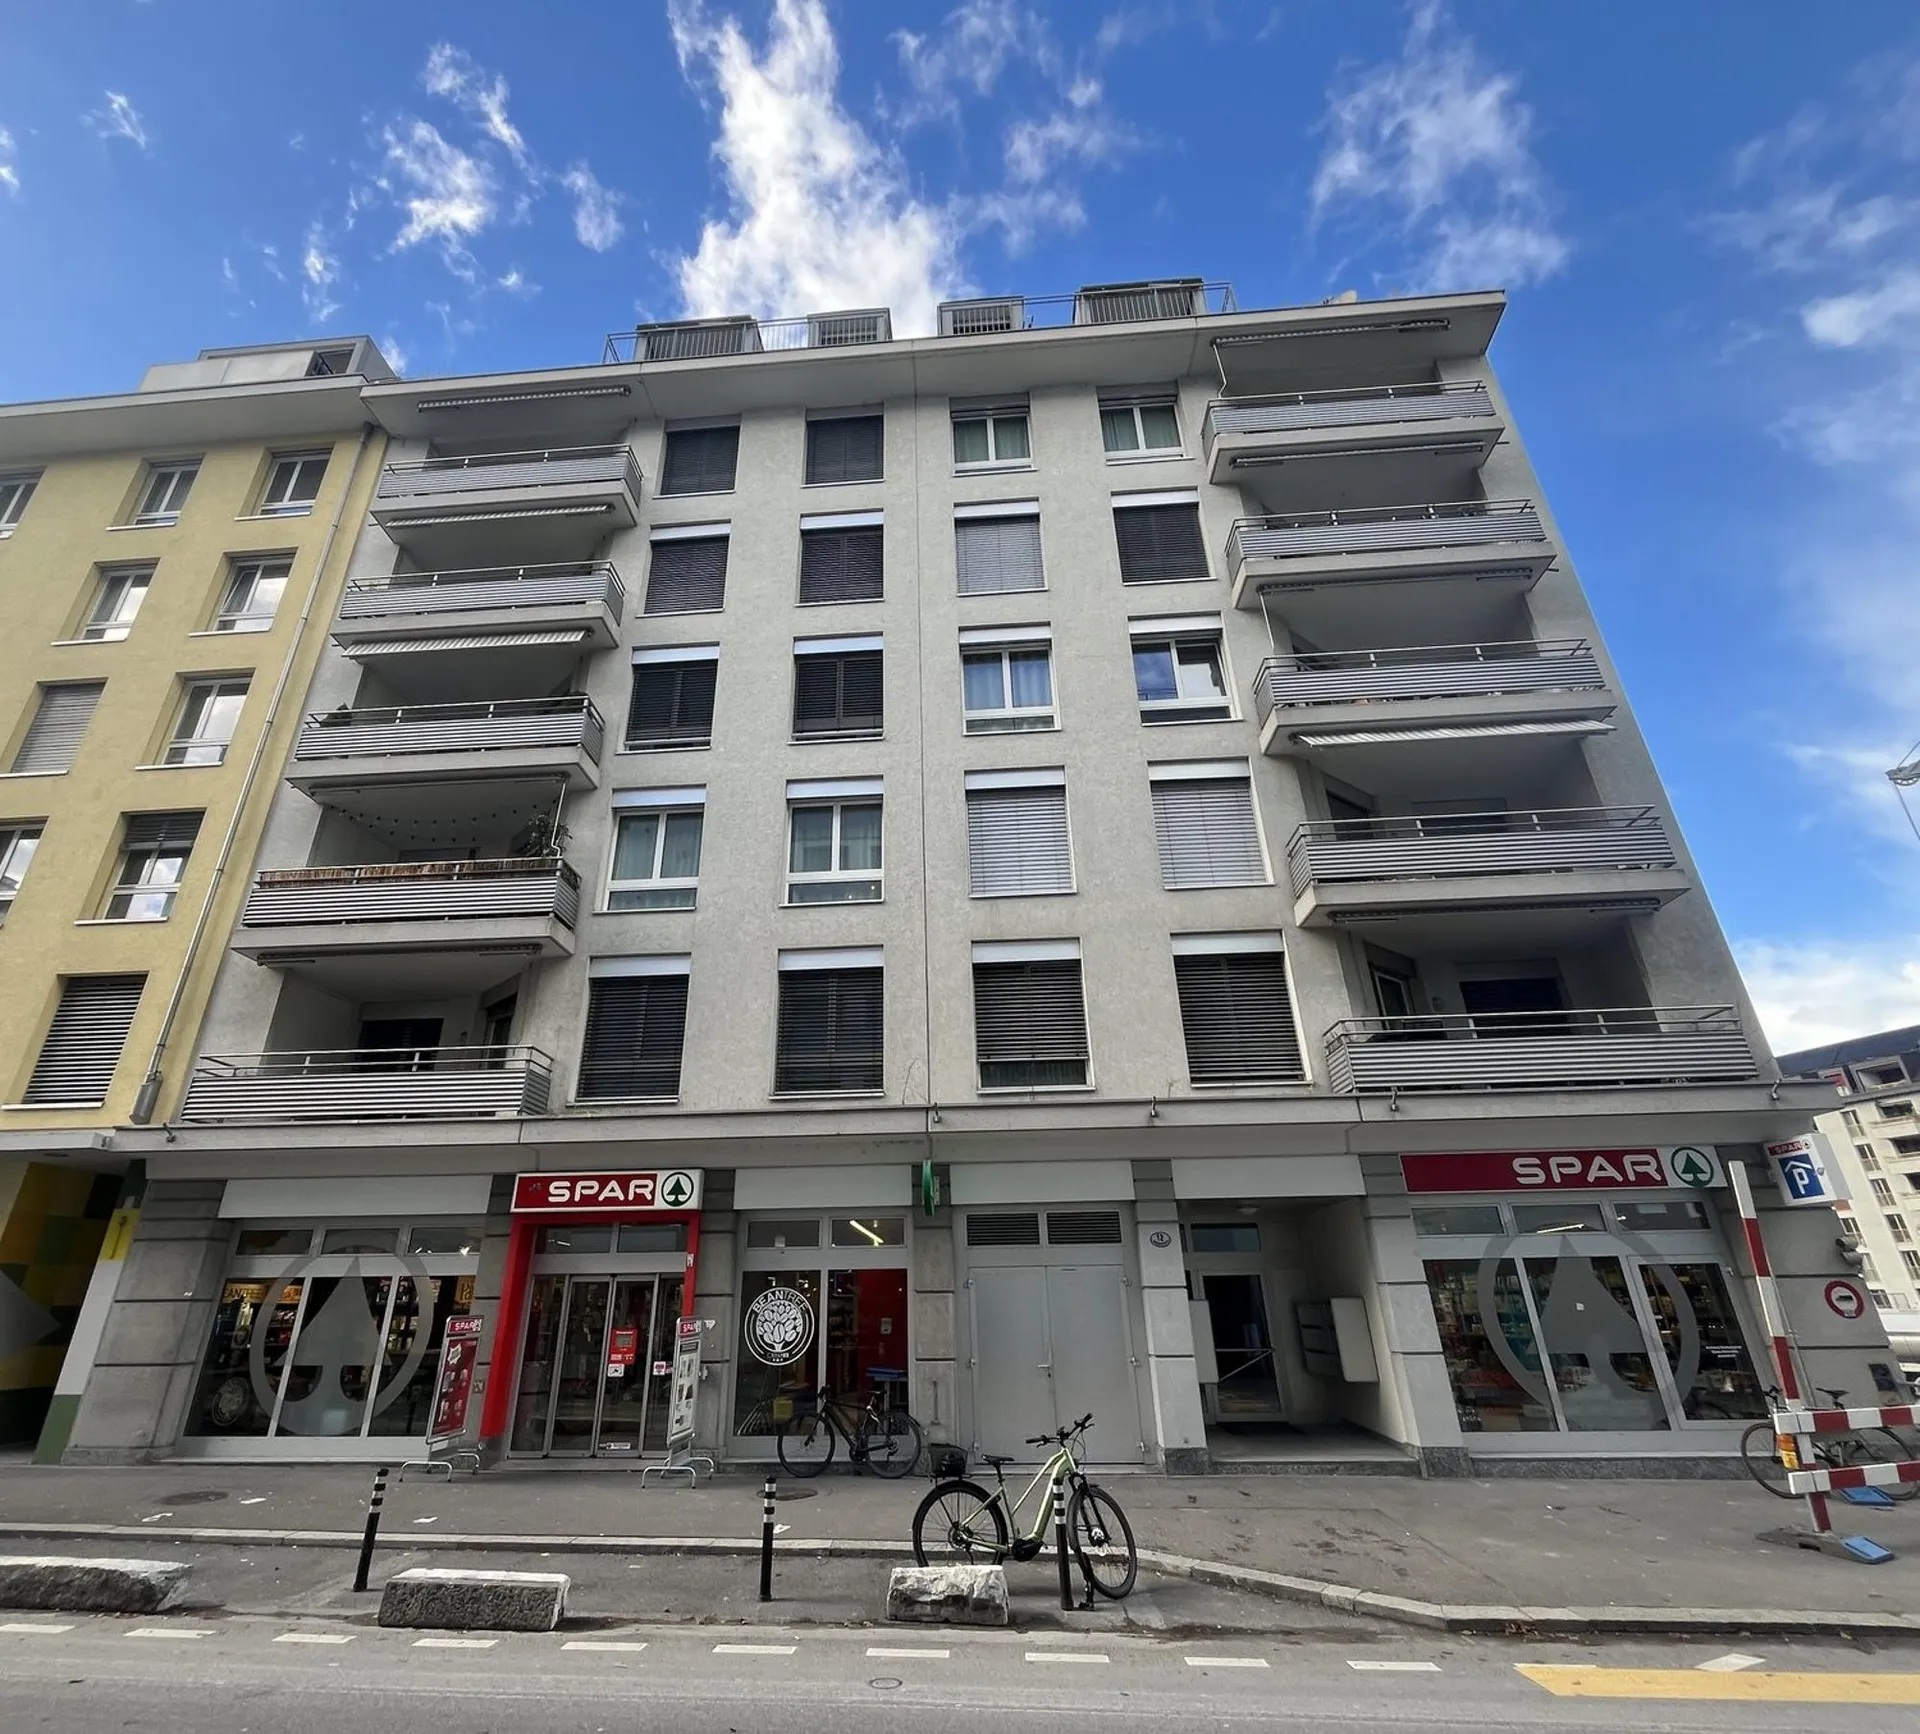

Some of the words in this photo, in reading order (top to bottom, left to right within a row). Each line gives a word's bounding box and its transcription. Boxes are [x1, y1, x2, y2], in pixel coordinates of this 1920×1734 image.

[1774, 1142, 1803, 1153] SPAR
[1512, 1154, 1662, 1184] SPAR
[1792, 1167, 1809, 1194] P
[548, 1180, 654, 1203] SPAR
[752, 1290, 809, 1314] BEANTREE
[455, 1321, 475, 1331] SPAR
